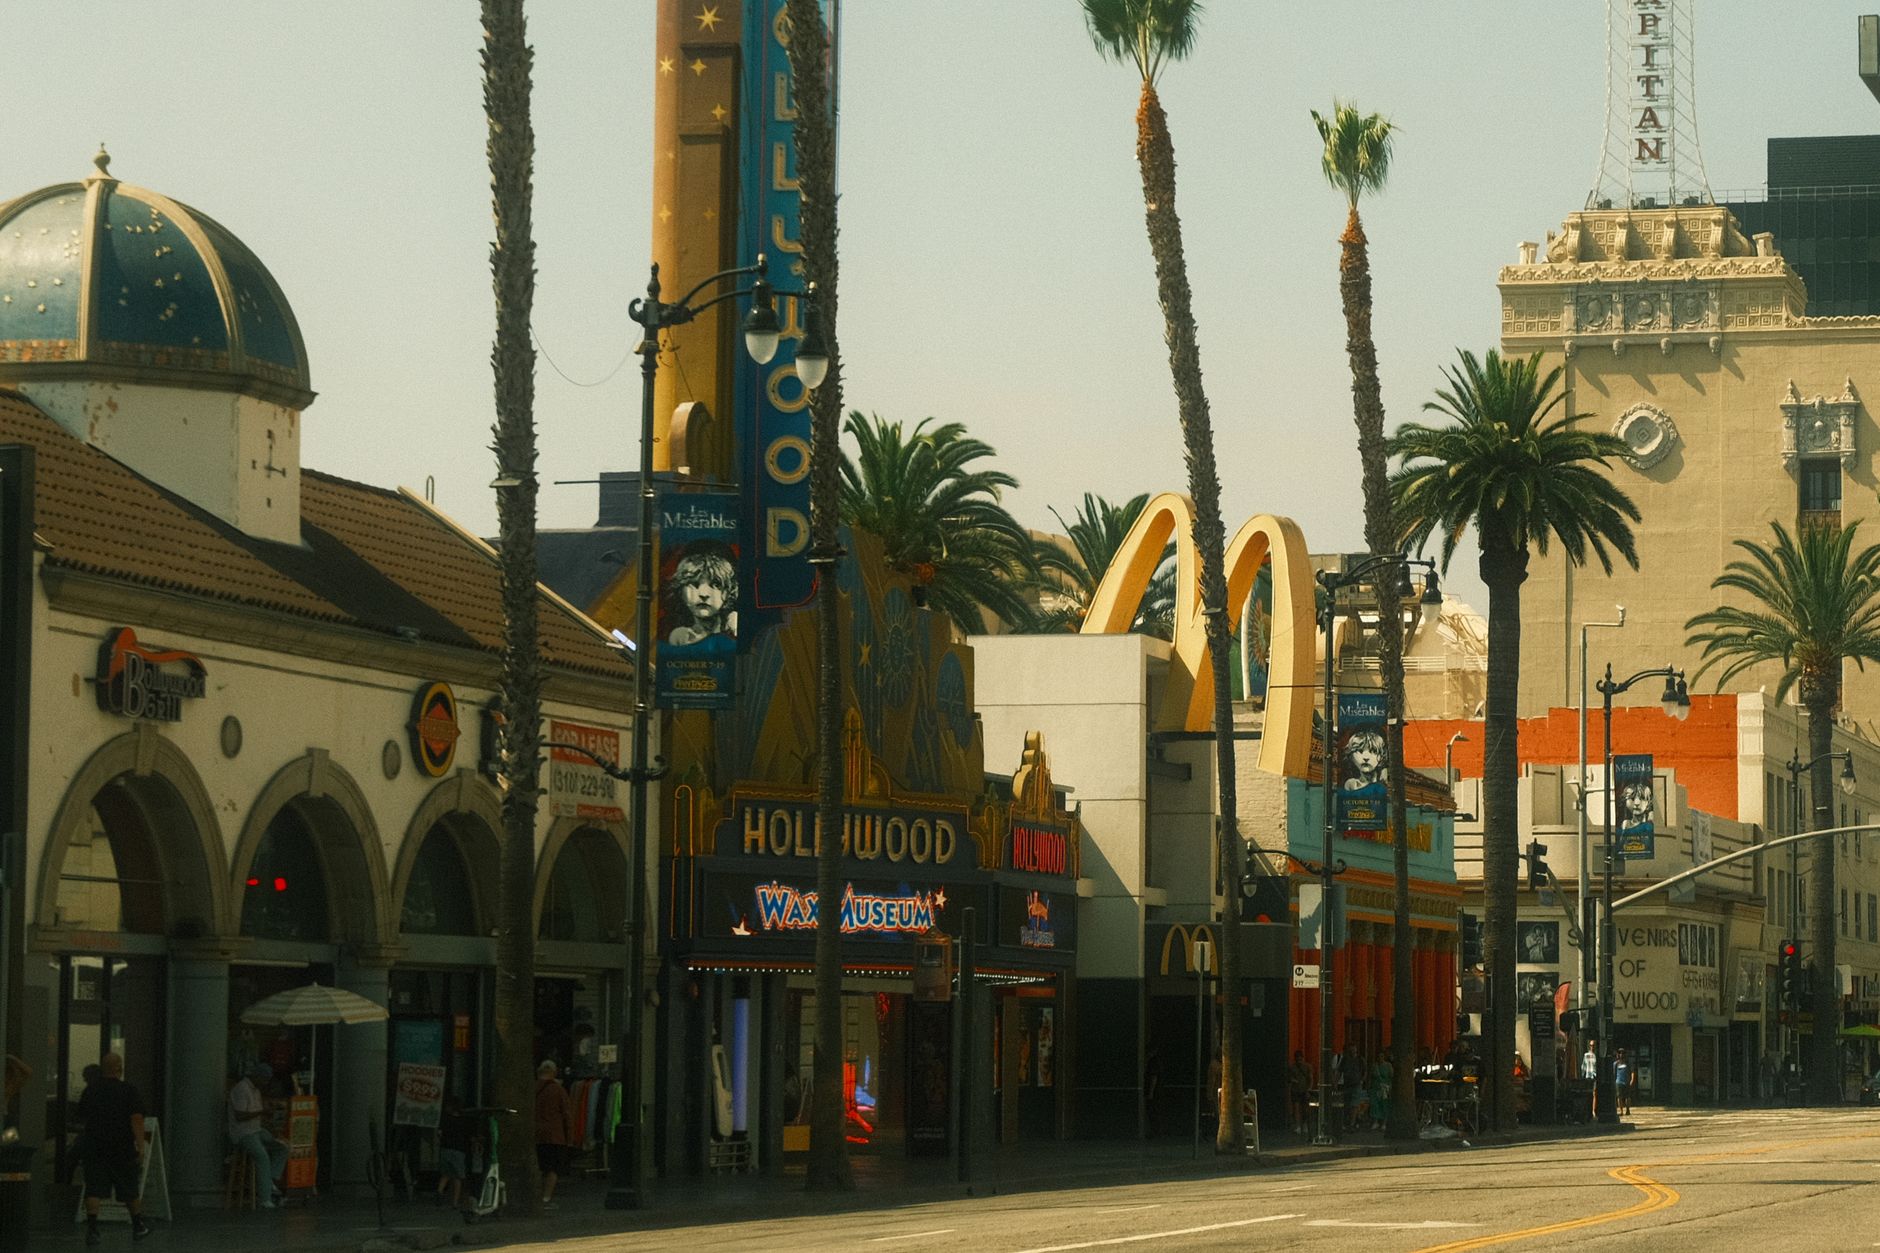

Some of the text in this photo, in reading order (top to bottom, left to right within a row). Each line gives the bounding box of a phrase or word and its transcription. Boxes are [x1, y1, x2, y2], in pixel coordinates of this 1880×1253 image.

[663, 511, 737, 529] Misérables
[690, 505, 708, 517] Les
[1013, 826, 1066, 874] HOLLYWOOD
[756, 881, 935, 933] WAX MUSEUM
[1619, 959, 1646, 978] OF
